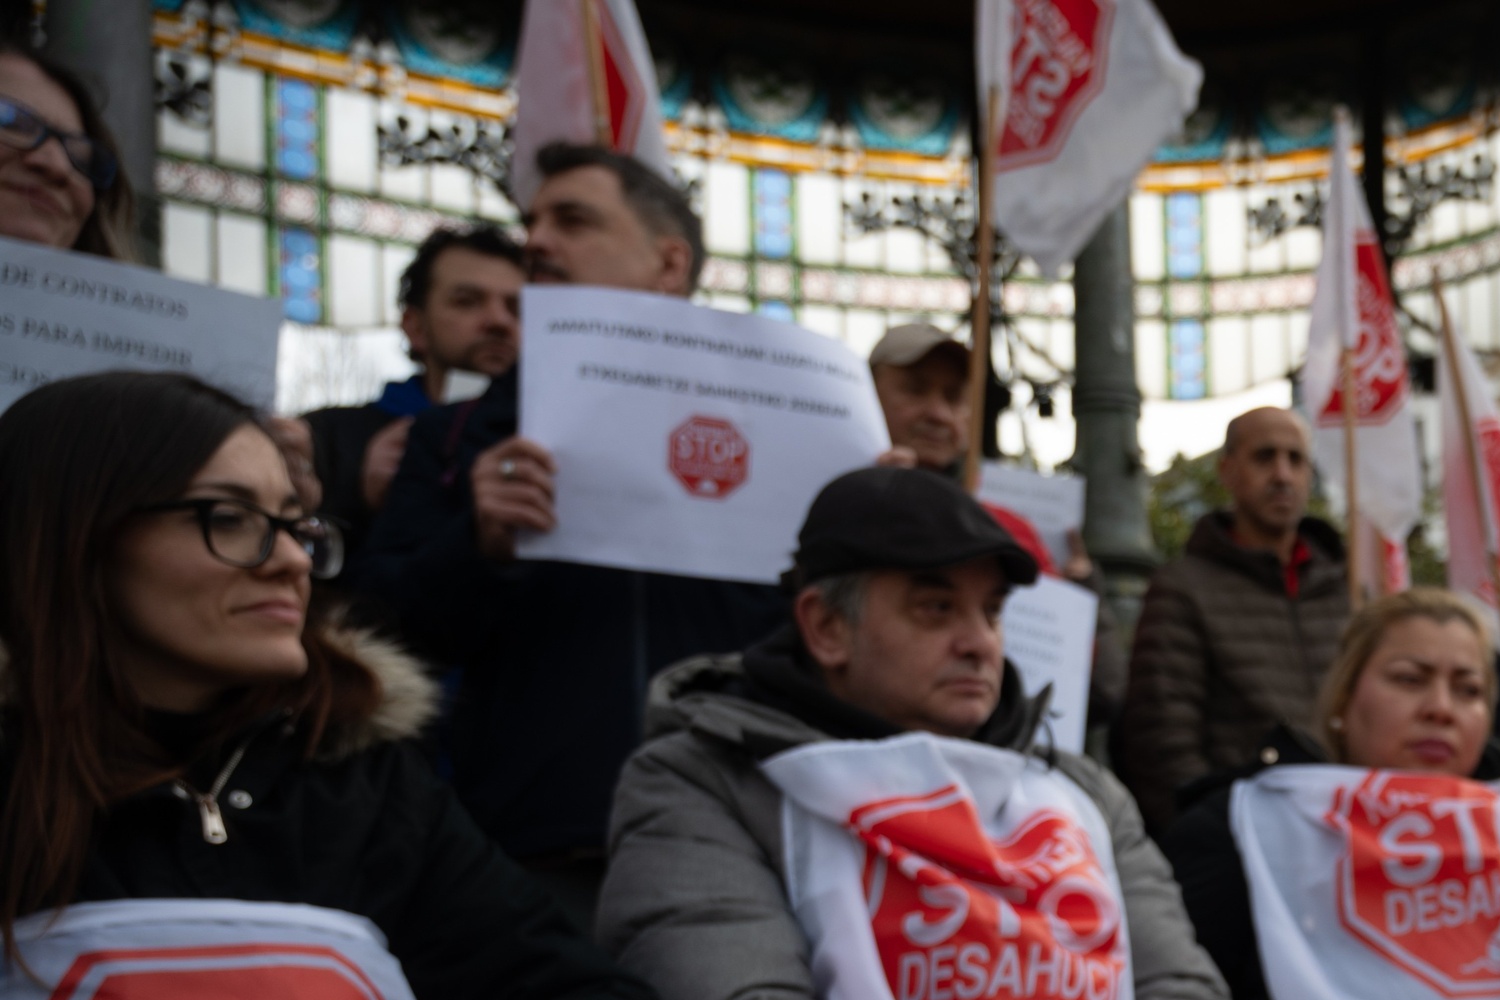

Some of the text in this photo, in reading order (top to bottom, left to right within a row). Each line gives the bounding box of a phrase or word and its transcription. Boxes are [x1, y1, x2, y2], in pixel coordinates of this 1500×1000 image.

[2, 262, 190, 321] DE CONTRATOS
[21, 316, 87, 349] PARA
[91, 331, 193, 367] IMPEDIR
[677, 431, 749, 463] STOP
